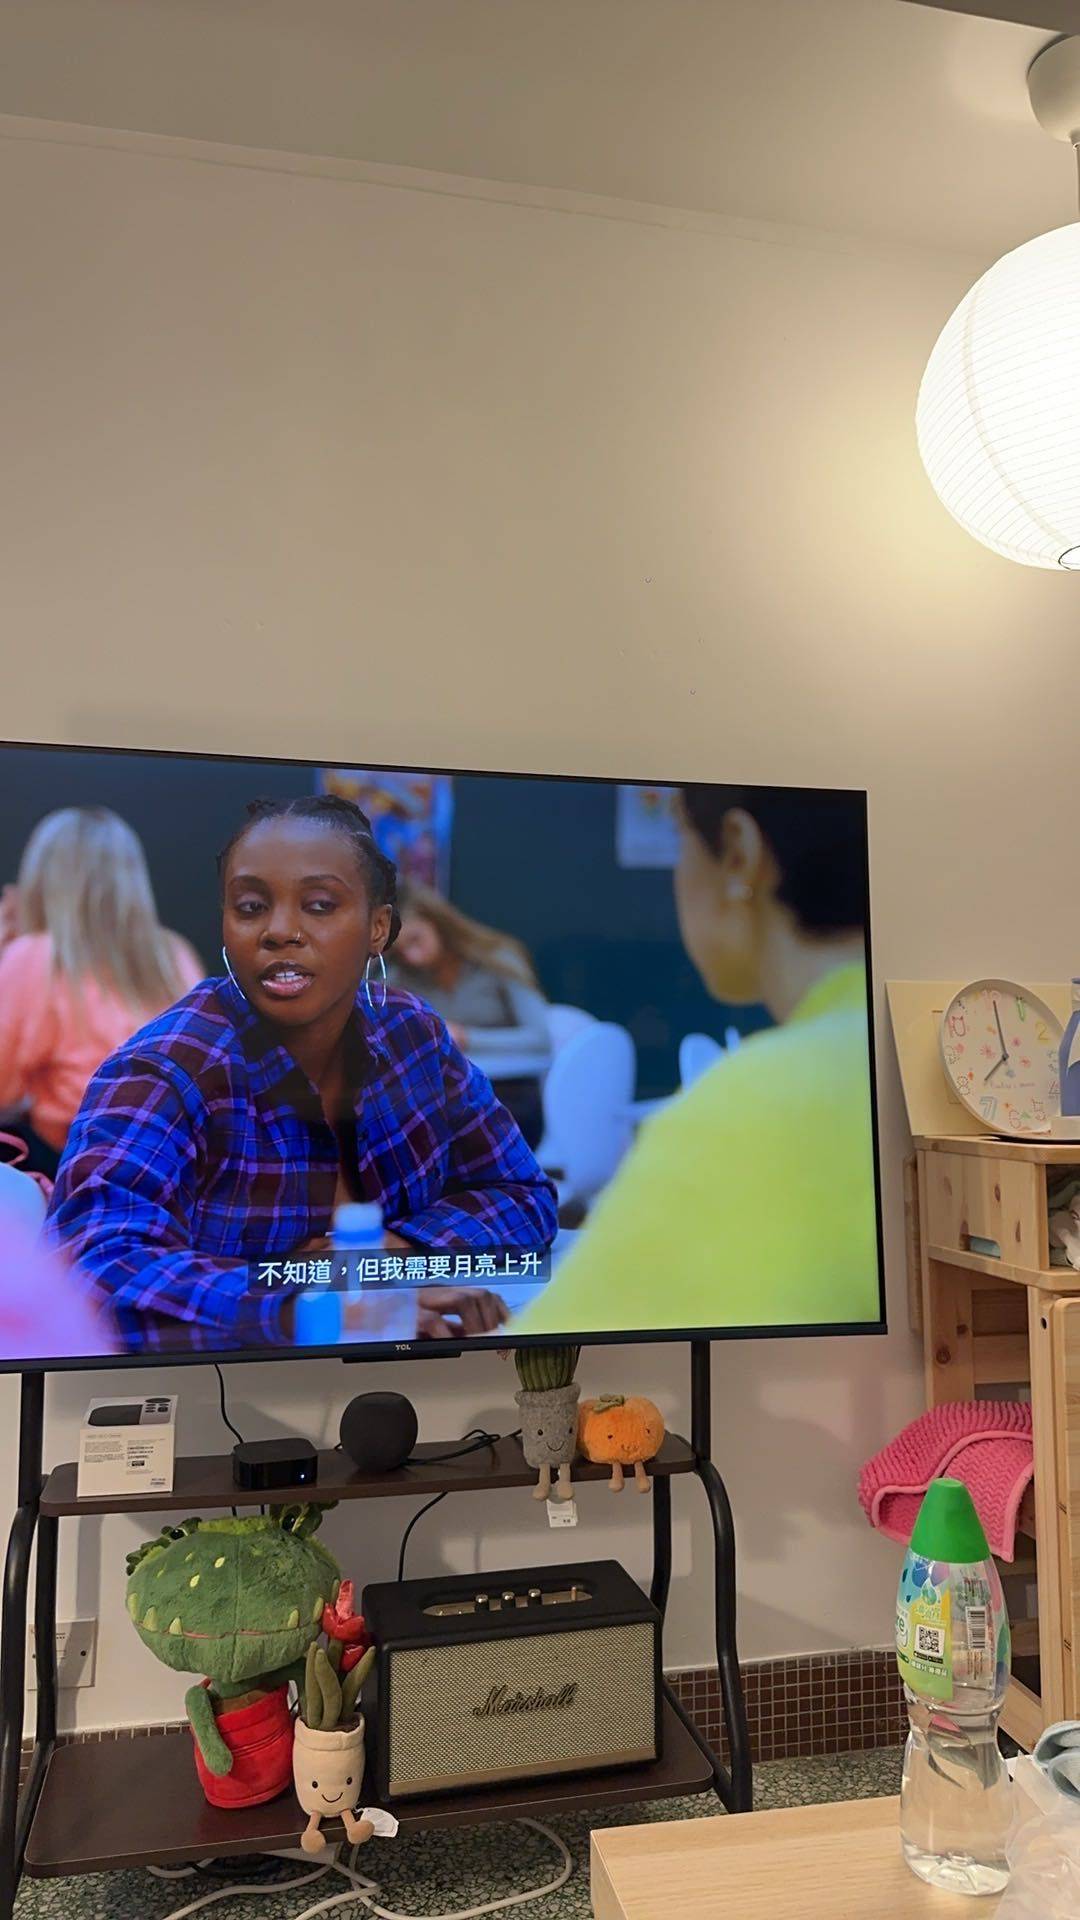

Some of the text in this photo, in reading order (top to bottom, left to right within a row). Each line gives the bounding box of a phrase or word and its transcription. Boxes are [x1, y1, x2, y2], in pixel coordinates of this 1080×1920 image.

[1035, 1021, 1049, 1042] 2
[957, 1075, 971, 1096] 8
[979, 1095, 998, 1120] 7
[257, 1251, 543, 1287] 不知道，但我需要月亮上升
[395, 1343, 412, 1351] TCL
[472, 1683, 580, 1718] Marshall
